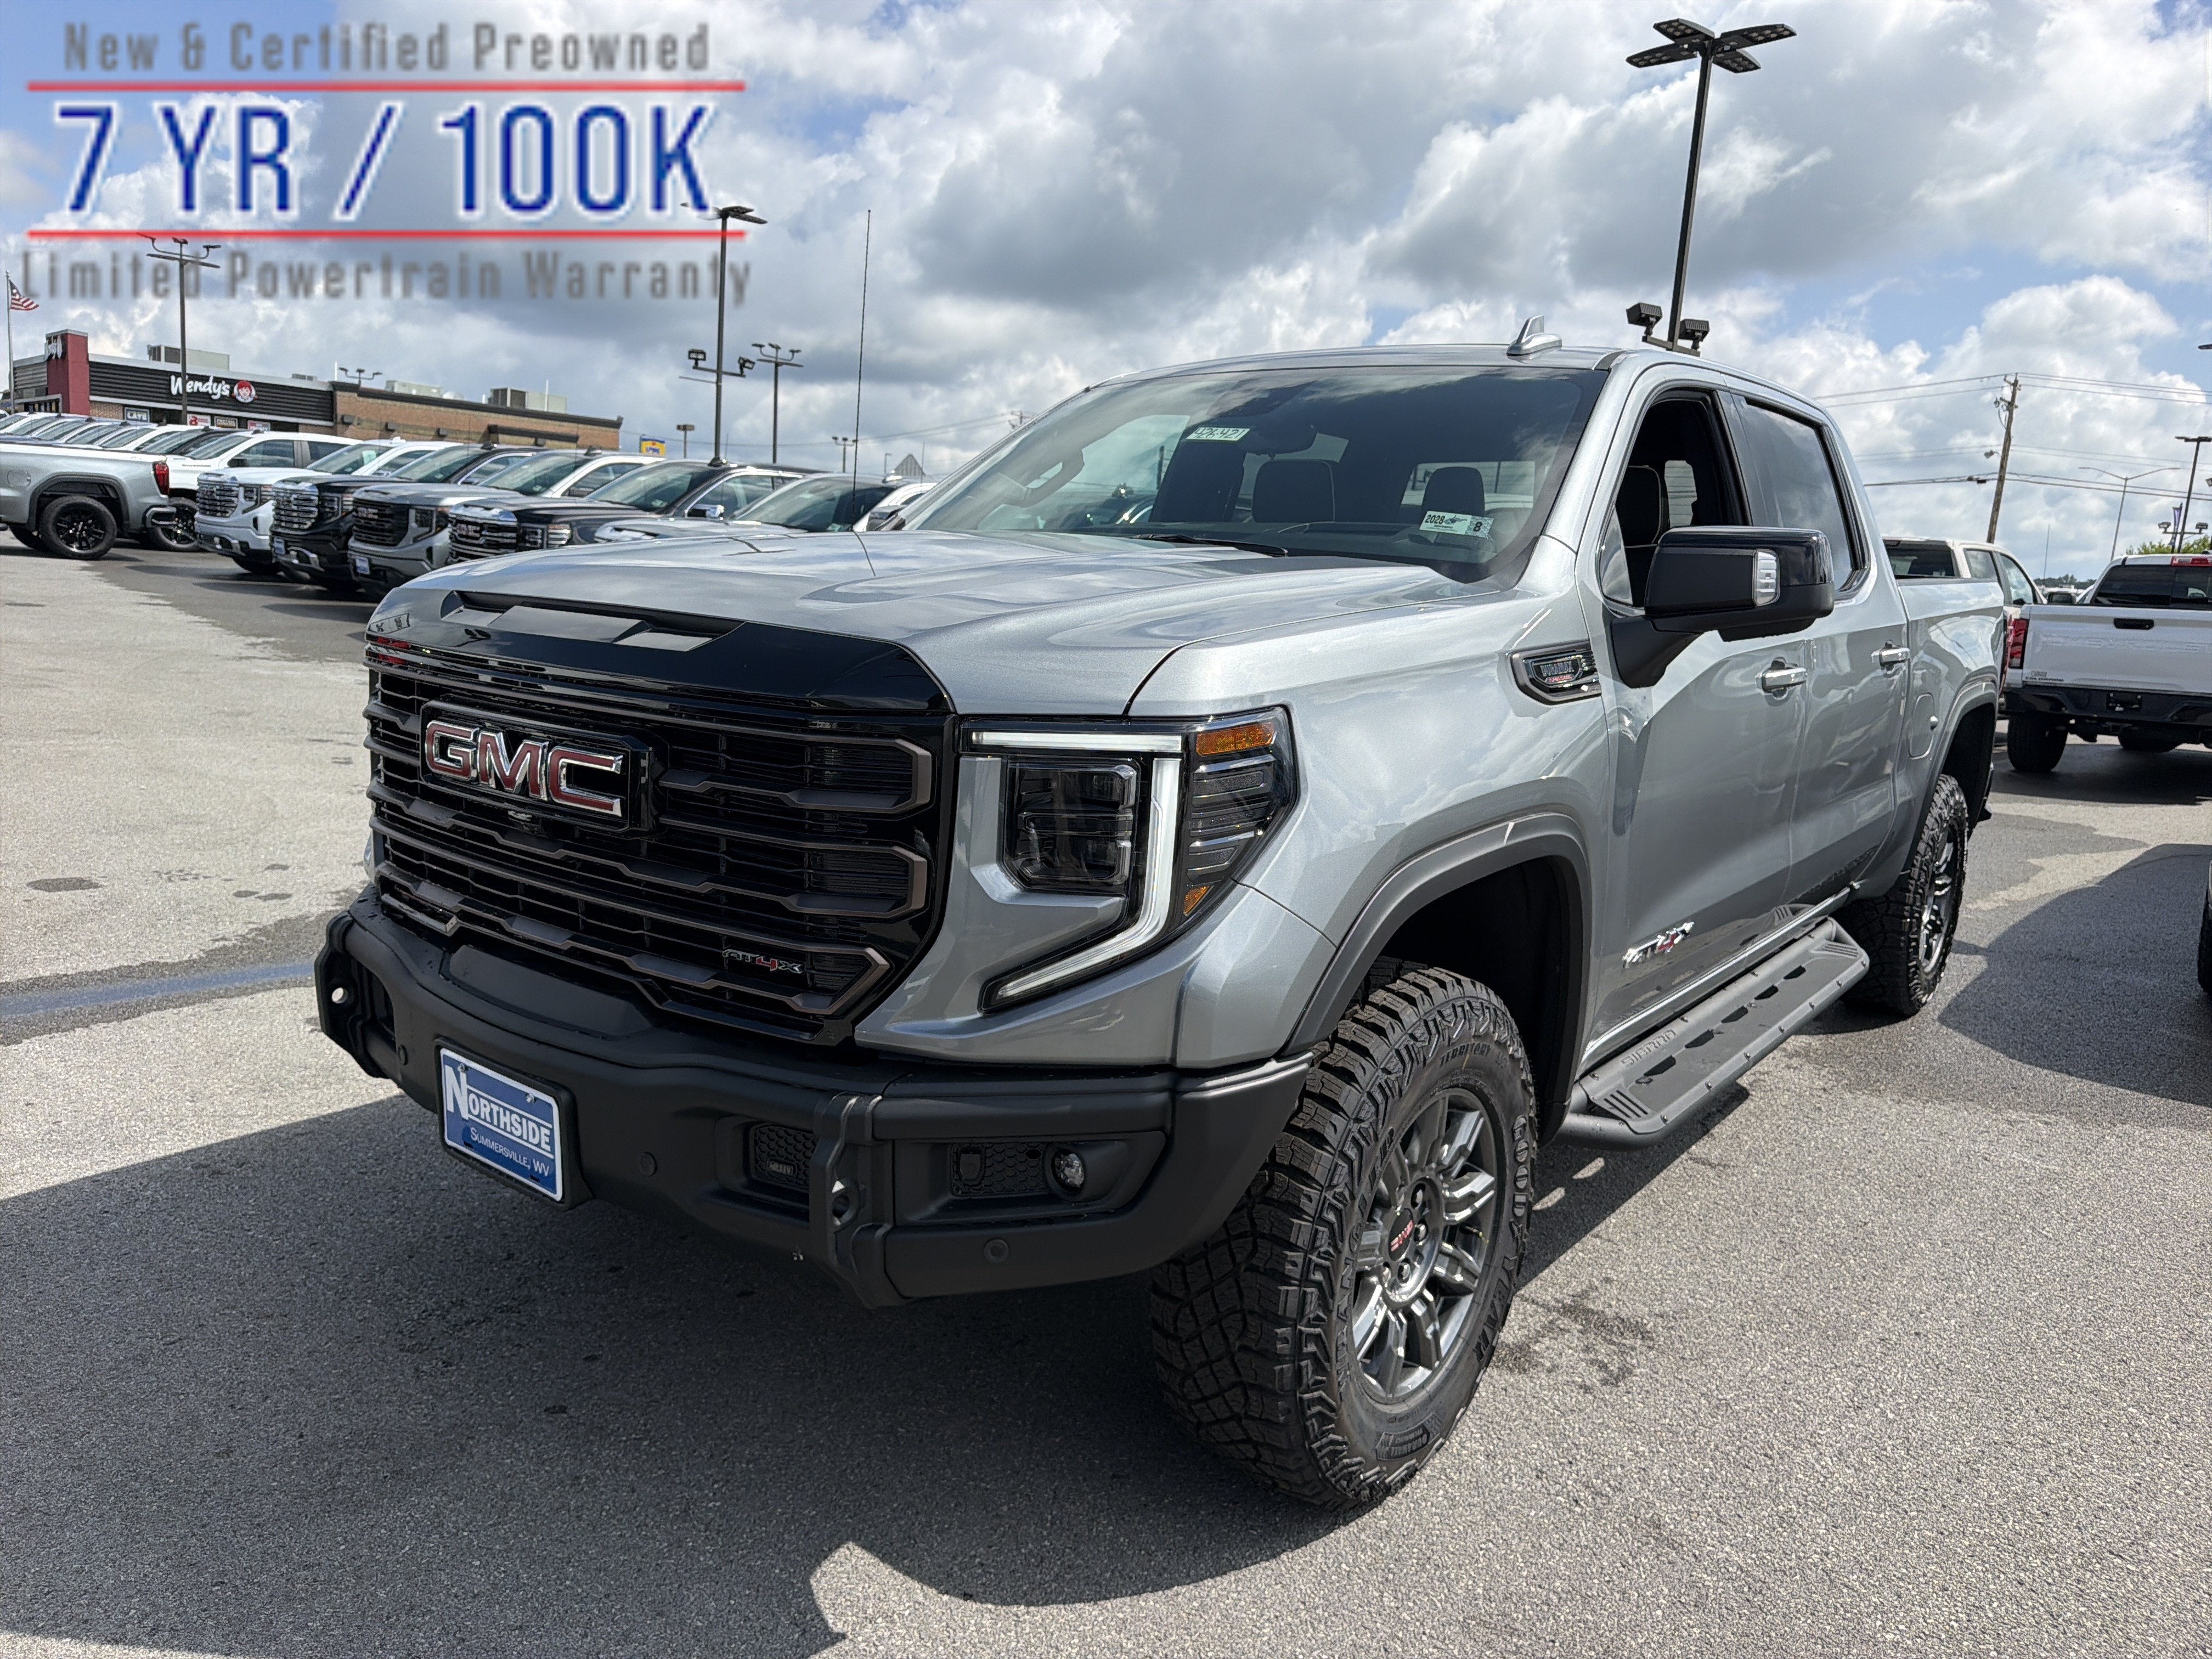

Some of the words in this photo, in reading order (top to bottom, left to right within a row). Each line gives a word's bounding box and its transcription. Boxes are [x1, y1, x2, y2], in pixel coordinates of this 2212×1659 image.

[170, 375, 230, 400] Wendy's
[1425, 514, 1445, 524] 2028
[1473, 521, 1482, 532] 8
[425, 720, 624, 817] GMC
[722, 949, 803, 974] AT4X
[445, 1064, 551, 1152] NORTHSIDE
[470, 1127, 531, 1170] SUMMERSVILLE,
[533, 1159, 550, 1177] WV
